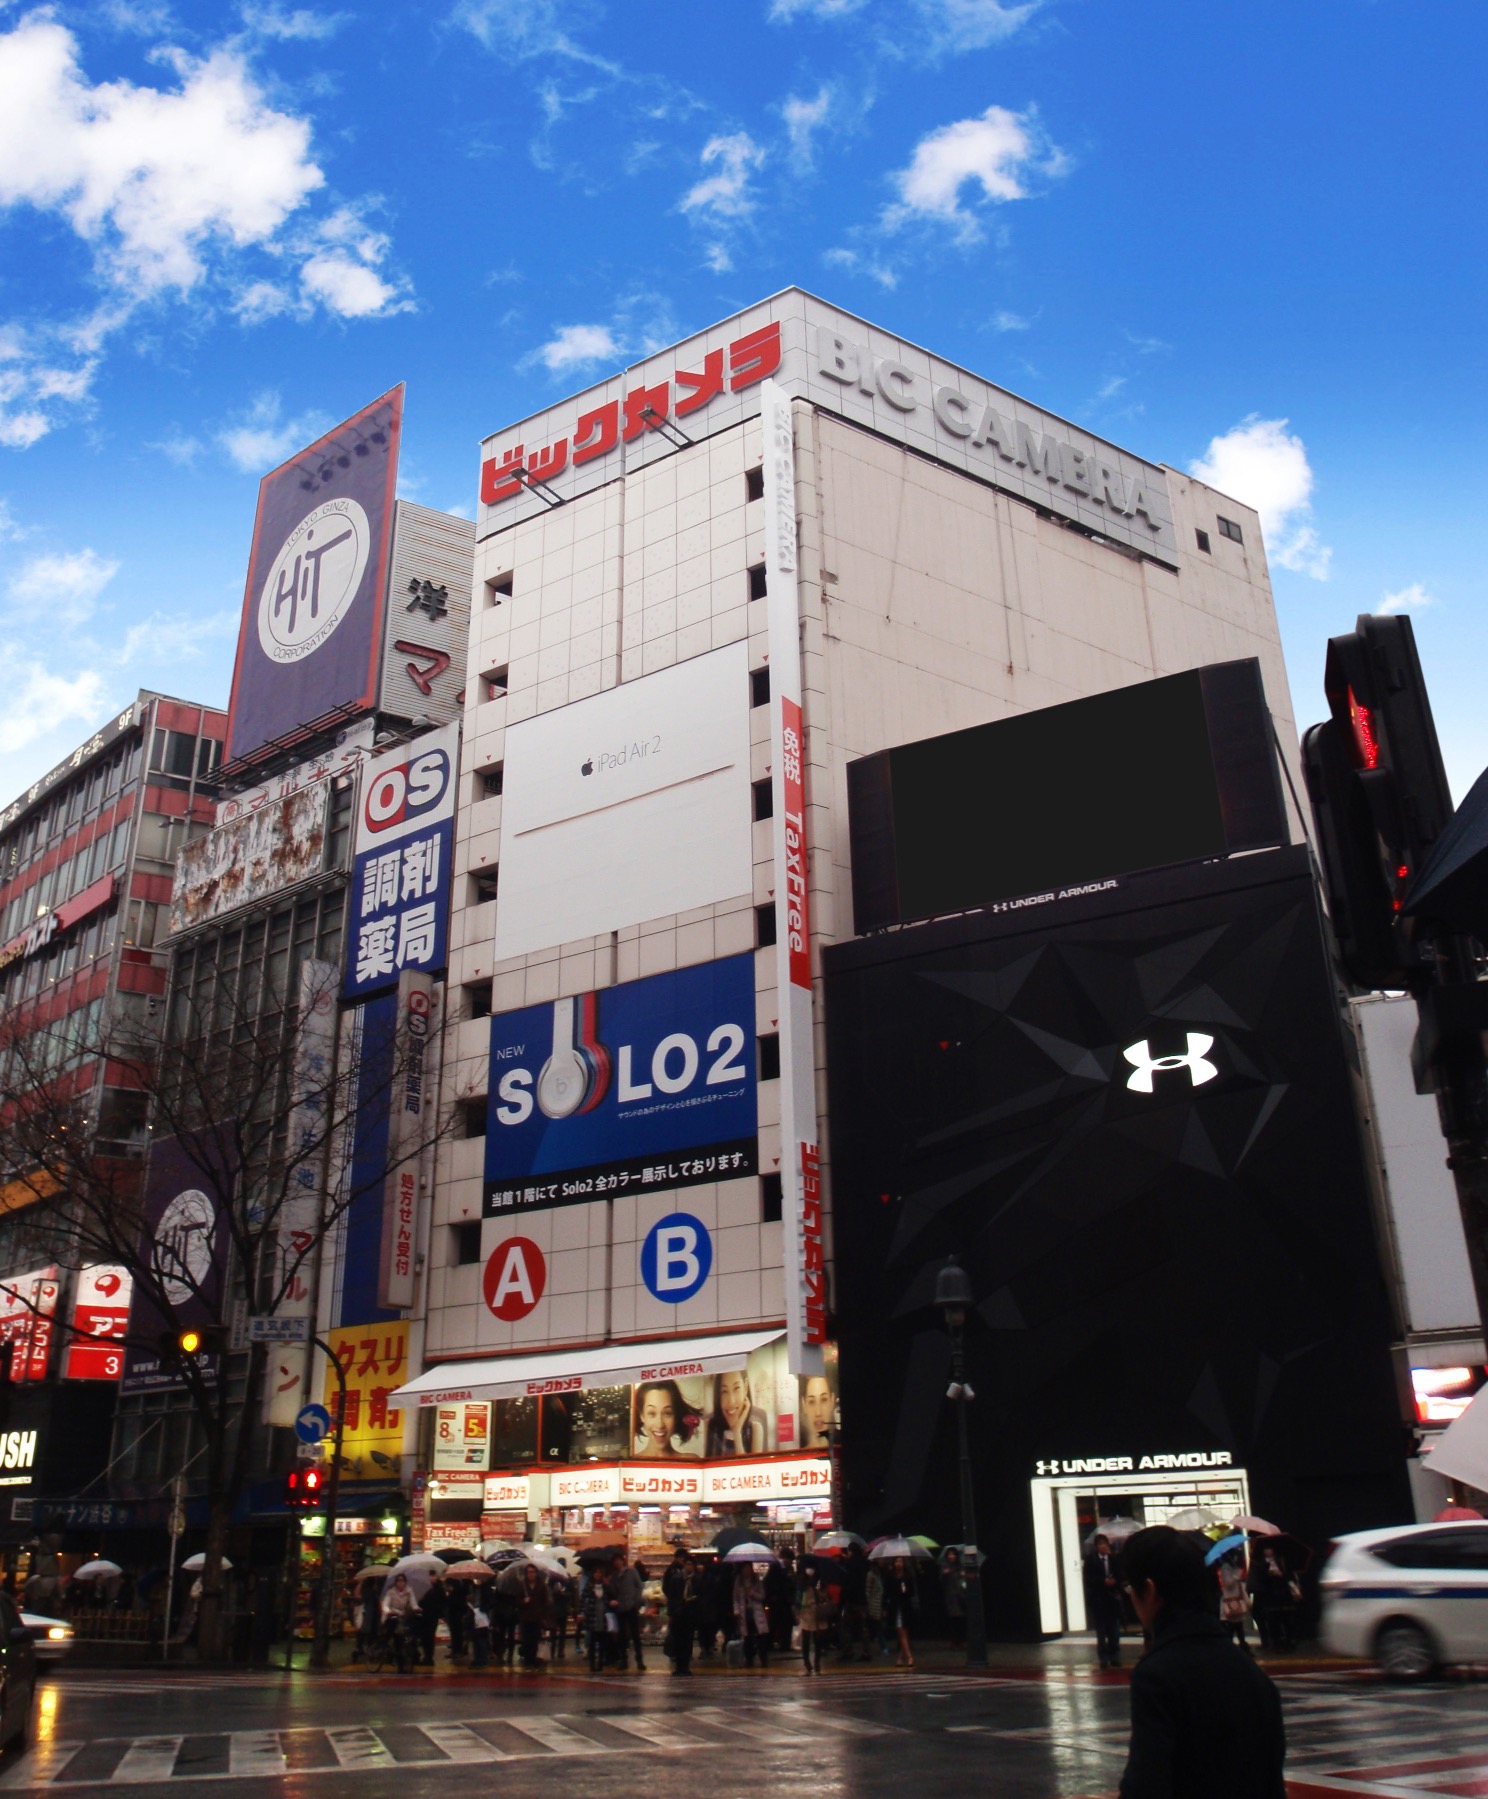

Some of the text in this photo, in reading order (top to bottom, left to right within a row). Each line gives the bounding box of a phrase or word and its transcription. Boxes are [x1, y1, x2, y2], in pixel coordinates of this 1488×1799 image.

[480, 320, 781, 506] ビックカメラ
[814, 325, 1163, 533] BIC CAMERA
[286, 501, 350, 548] TOKYO GINZA
[273, 614, 339, 660] CORPORATION
[394, 640, 466, 704] マ
[118, 708, 133, 731] 9F
[597, 735, 662, 772] iPad Air 2
[783, 727, 801, 785] 免税
[28, 784, 39, 804] 9F
[368, 753, 445, 823] OS
[361, 833, 441, 918] 調剤
[1010, 880, 1117, 909] UNDER ARMOUR
[356, 901, 436, 984] 薬局
[409, 990, 430, 1036] OS
[497, 1045, 526, 1060] NEW
[562, 1179, 593, 1196] Solo2
[396, 1172, 414, 1277] 処方せん受付
[655, 1225, 700, 1291] B
[491, 1246, 535, 1308] A
[278, 1231, 313, 1392] マルン
[105, 1357, 119, 1375] 3
[336, 1336, 404, 1381] クスリ
[641, 1362, 703, 1380] BIC CAMERA
[420, 1391, 472, 1404] BIC CAMERA
[526, 1377, 582, 1394] ビックカメラ
[450, 1473, 480, 1481] CAMERA
[1062, 1452, 1232, 1473] UNDER ARMOUR
[486, 1485, 527, 1501] ビックカメラ
[559, 1482, 572, 1495] BIC
[623, 1477, 698, 1493] ビックカメラ
[712, 1475, 771, 1491] BIC CAMERA
[426, 1527, 444, 1537] Tax
